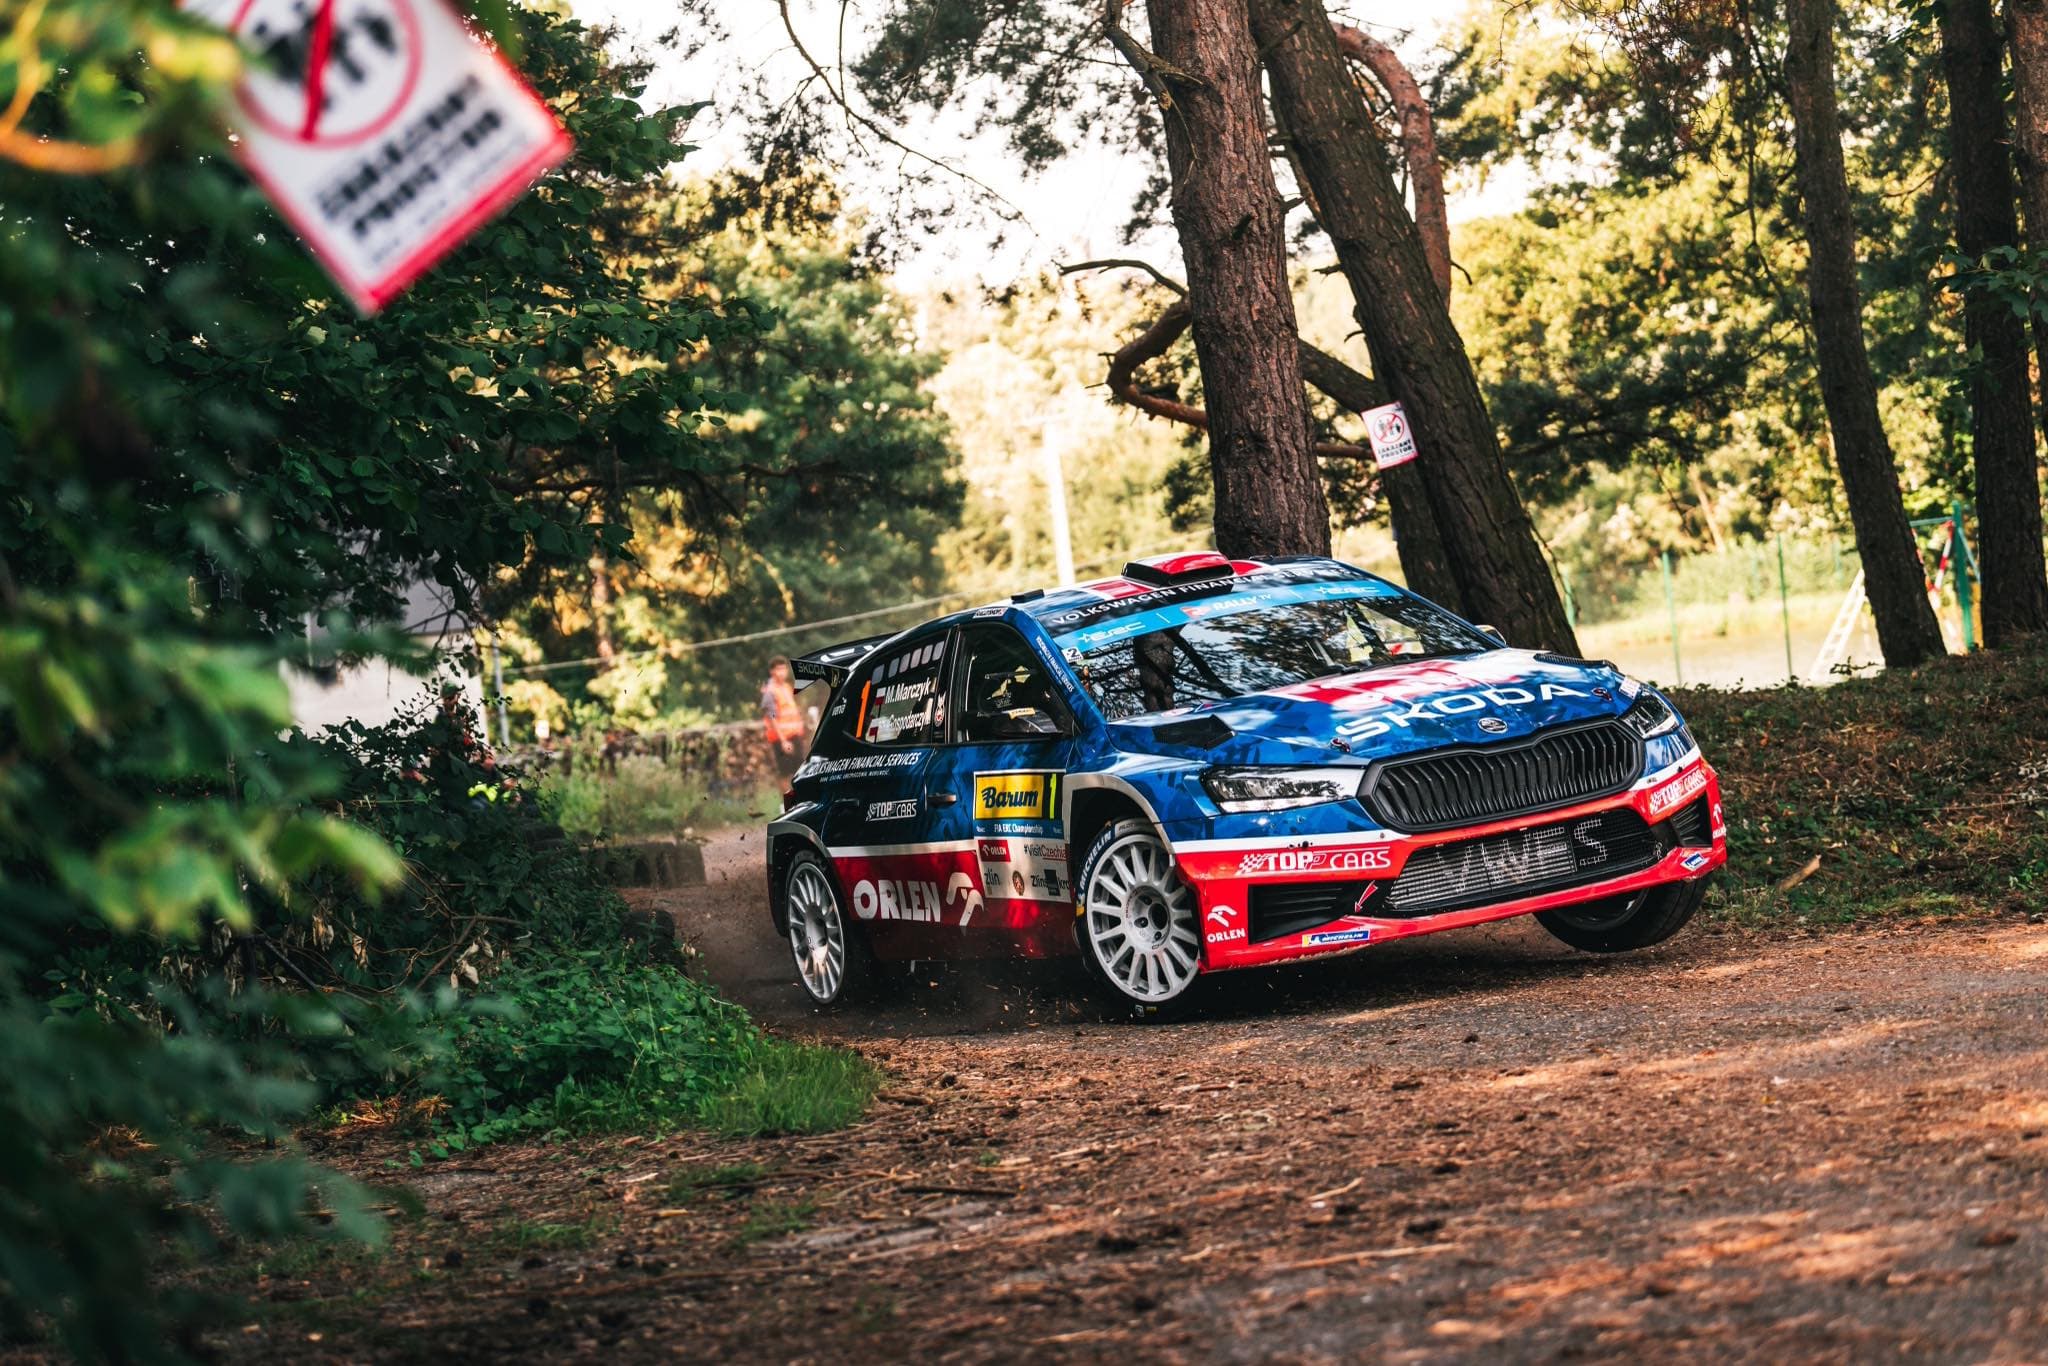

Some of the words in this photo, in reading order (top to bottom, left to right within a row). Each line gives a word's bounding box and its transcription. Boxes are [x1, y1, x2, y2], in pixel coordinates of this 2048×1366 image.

[1053, 588, 1177, 625] VOLKSWAGEN
[849, 755, 886, 770] FINANCIAL
[885, 752, 922, 768] SERVICES
[981, 786, 1039, 809] Barum
[1049, 773, 1057, 819] 1
[875, 802, 893, 817] TOP
[896, 802, 917, 818] CARS
[990, 845, 1007, 856] ORLEN
[1079, 830, 1112, 890] MICHELIN
[1262, 851, 1315, 871] TOP
[1330, 850, 1392, 871] CARS
[853, 879, 941, 923] ORLEN
[1207, 927, 1246, 943] ORLEN
[1321, 932, 1364, 943] MICHELIN
